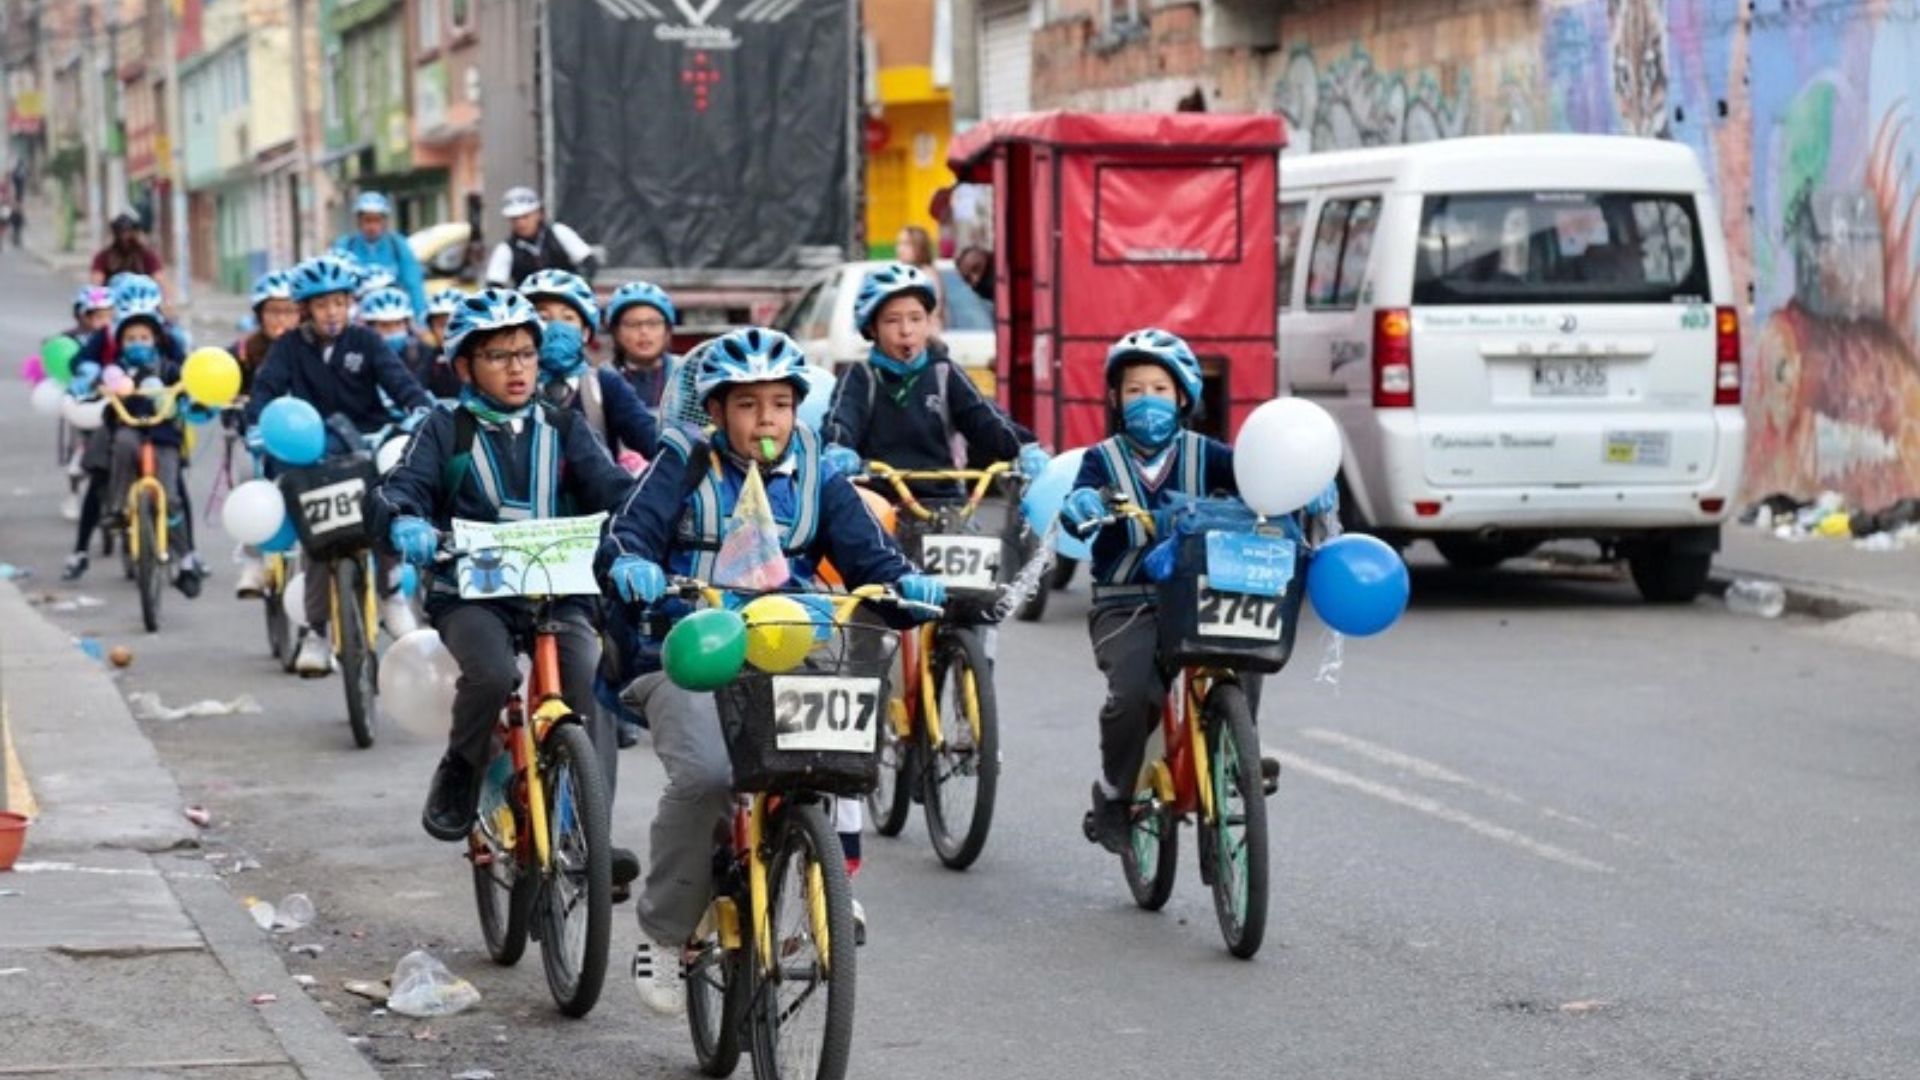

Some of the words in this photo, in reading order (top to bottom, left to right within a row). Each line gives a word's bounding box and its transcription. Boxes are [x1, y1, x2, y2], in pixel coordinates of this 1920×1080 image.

[925, 545, 1001, 583] 2674
[1198, 589, 1284, 630] 2747
[775, 689, 876, 733] 2707
